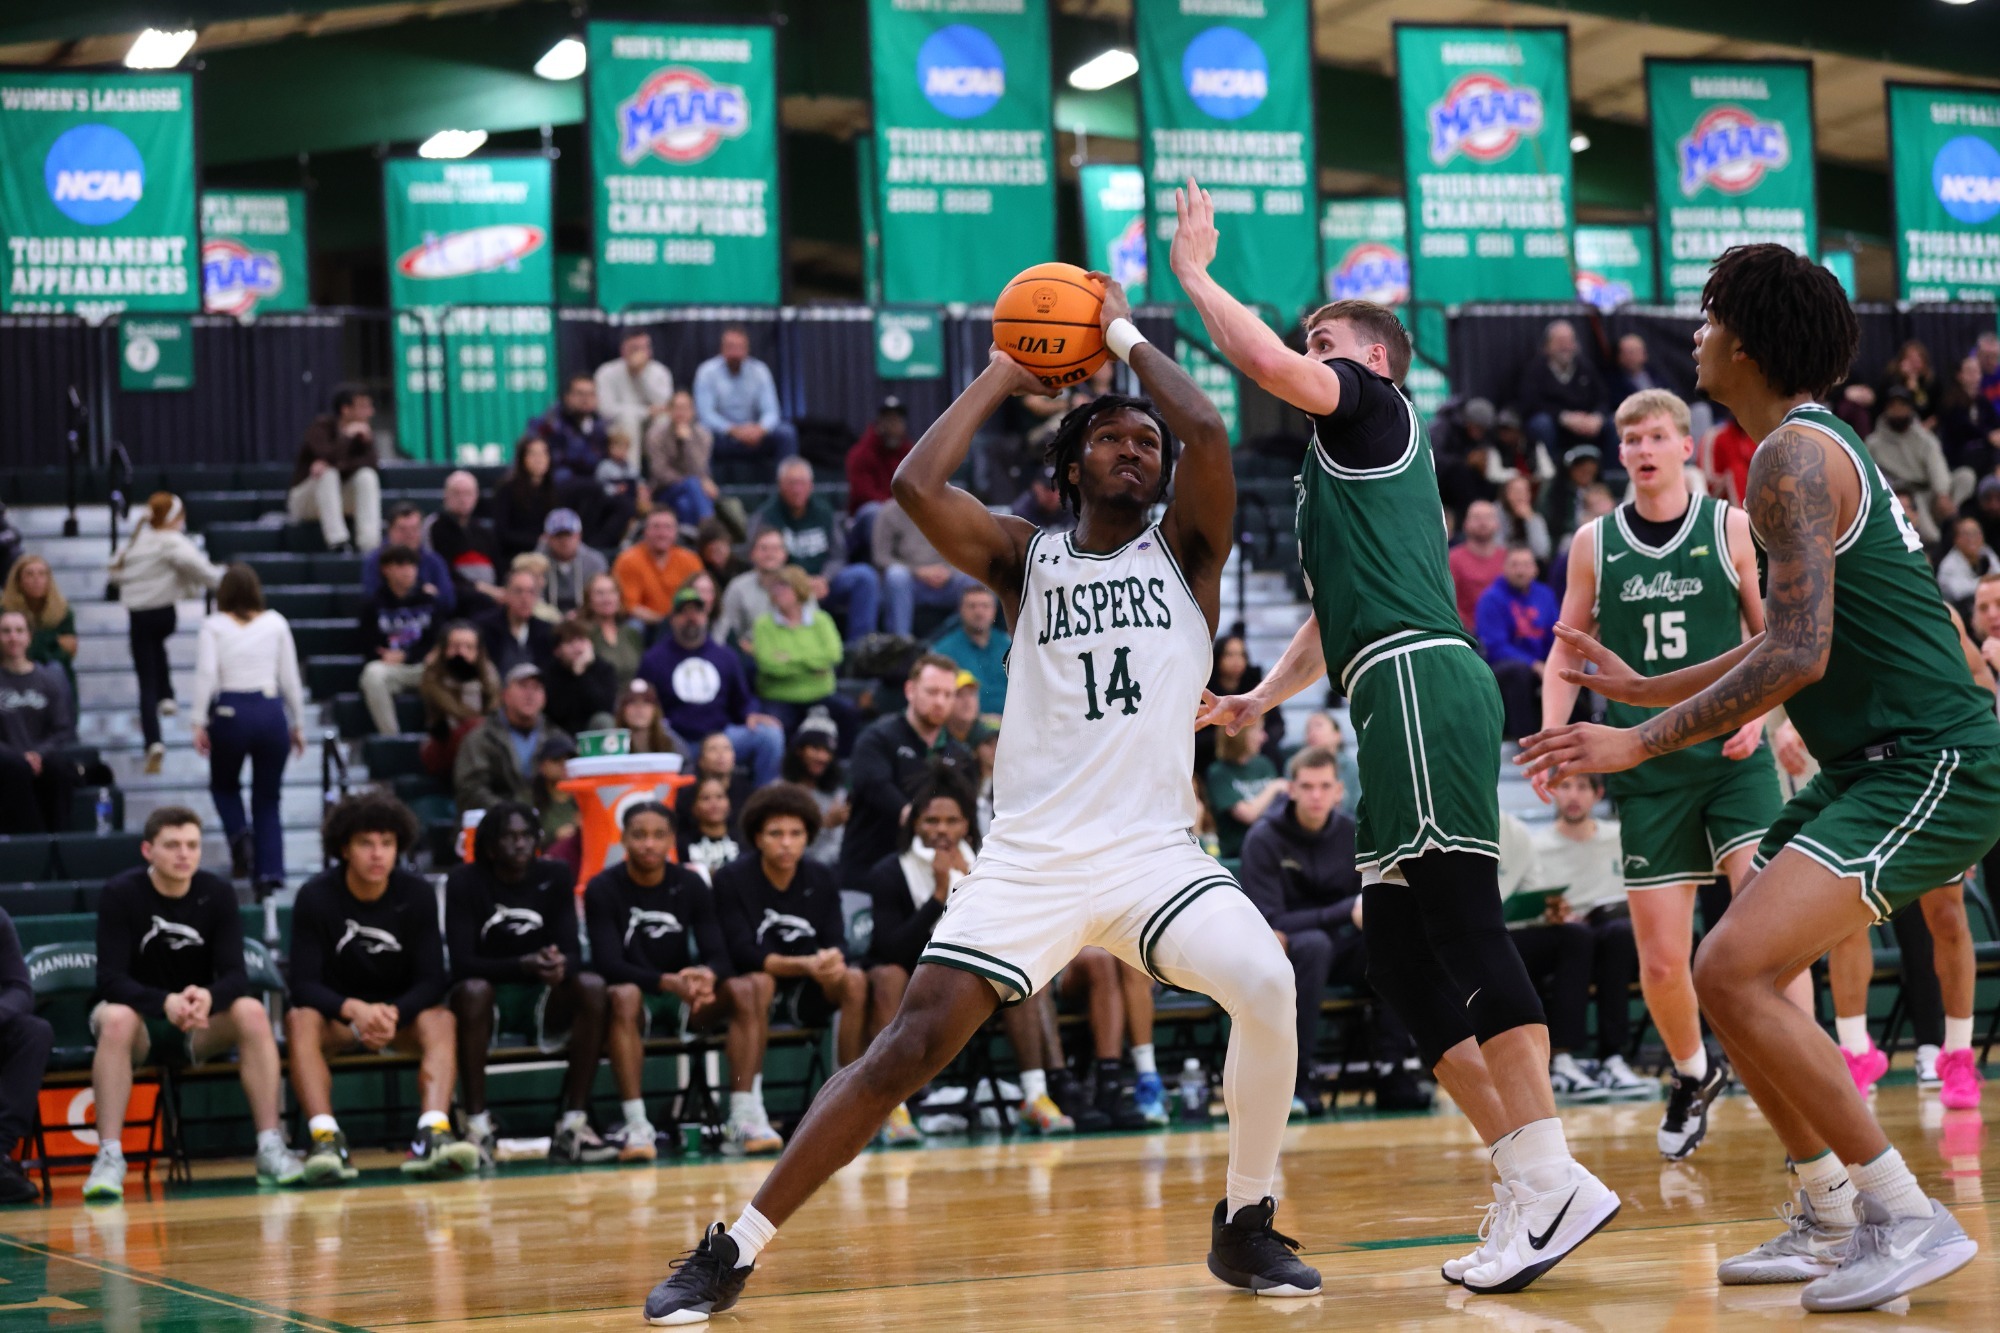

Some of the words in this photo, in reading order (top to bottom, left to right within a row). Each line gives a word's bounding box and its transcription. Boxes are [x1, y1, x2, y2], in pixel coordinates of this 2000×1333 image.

[925, 66, 1006, 97] NCAA
[1190, 67, 1268, 99] NCAA
[0, 87, 89, 112] WOMEN'S
[91, 88, 182, 112] LACROSSE
[621, 84, 744, 160] MAAC
[1430, 86, 1540, 160] MAAC
[885, 127, 1045, 157] TOURNAMENT
[1152, 128, 1304, 157] TOURNAMENT
[1680, 122, 1786, 190] MAAC
[55, 170, 143, 202] NCAA
[886, 156, 1047, 186] APPEARANCES
[1153, 156, 1307, 187] APPEARANCES
[1418, 173, 1564, 199] TOURNAMENT
[604, 175, 767, 206] TOURNAMENT
[607, 201, 767, 237] CHAMPIONS
[1421, 199, 1566, 228] CHAMPIONS
[8, 236, 187, 265] TOURNAMENT
[10, 266, 188, 295] APPEARANCES
[1017, 336, 1066, 355] EVO
[1038, 576, 1172, 646] JASPERS
[1642, 610, 1688, 661] 15
[1077, 646, 1142, 721] 14
